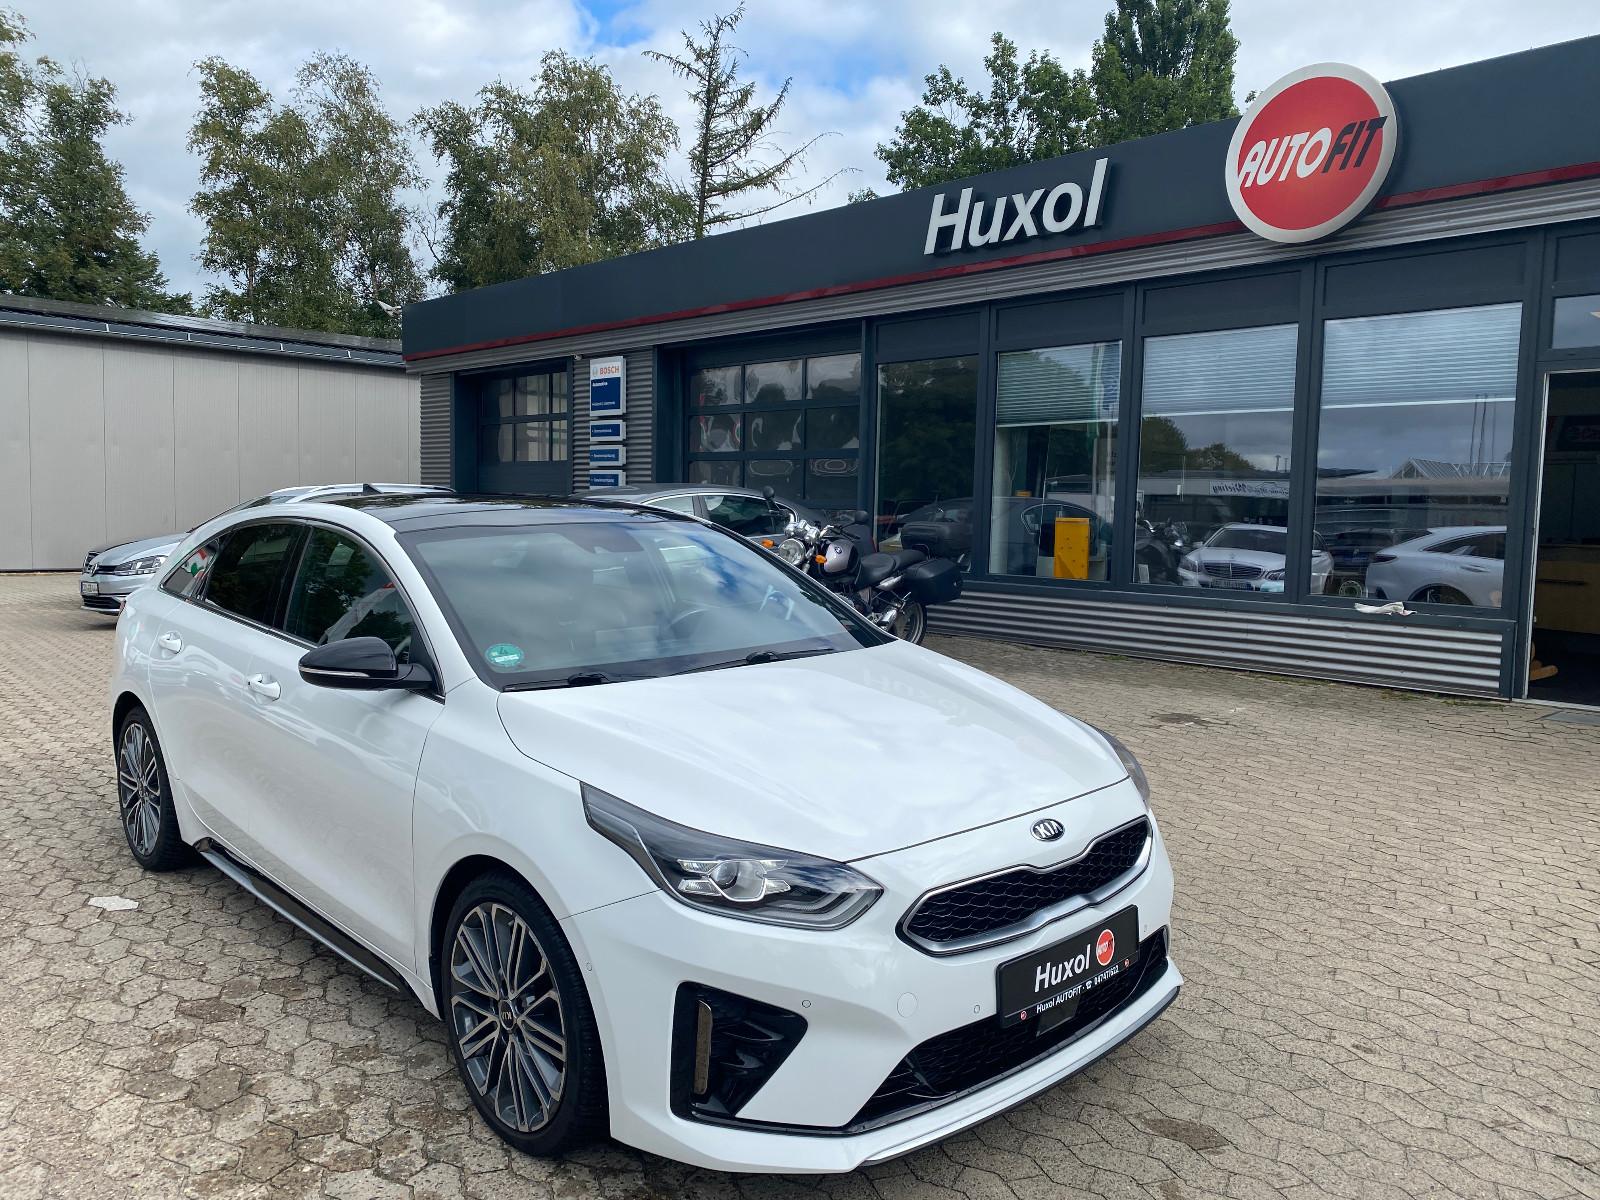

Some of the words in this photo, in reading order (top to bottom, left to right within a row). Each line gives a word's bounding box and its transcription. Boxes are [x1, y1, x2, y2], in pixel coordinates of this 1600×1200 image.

[1238, 115, 1387, 189] AUTOFIT
[923, 157, 1109, 255] Huxol
[599, 366, 620, 375] BOSCH
[1034, 820, 1063, 838] KIA
[1034, 943, 1091, 993] Huxol
[1036, 1000, 1055, 1014] Huxol
[1055, 985, 1082, 1006] AUTOFIT
